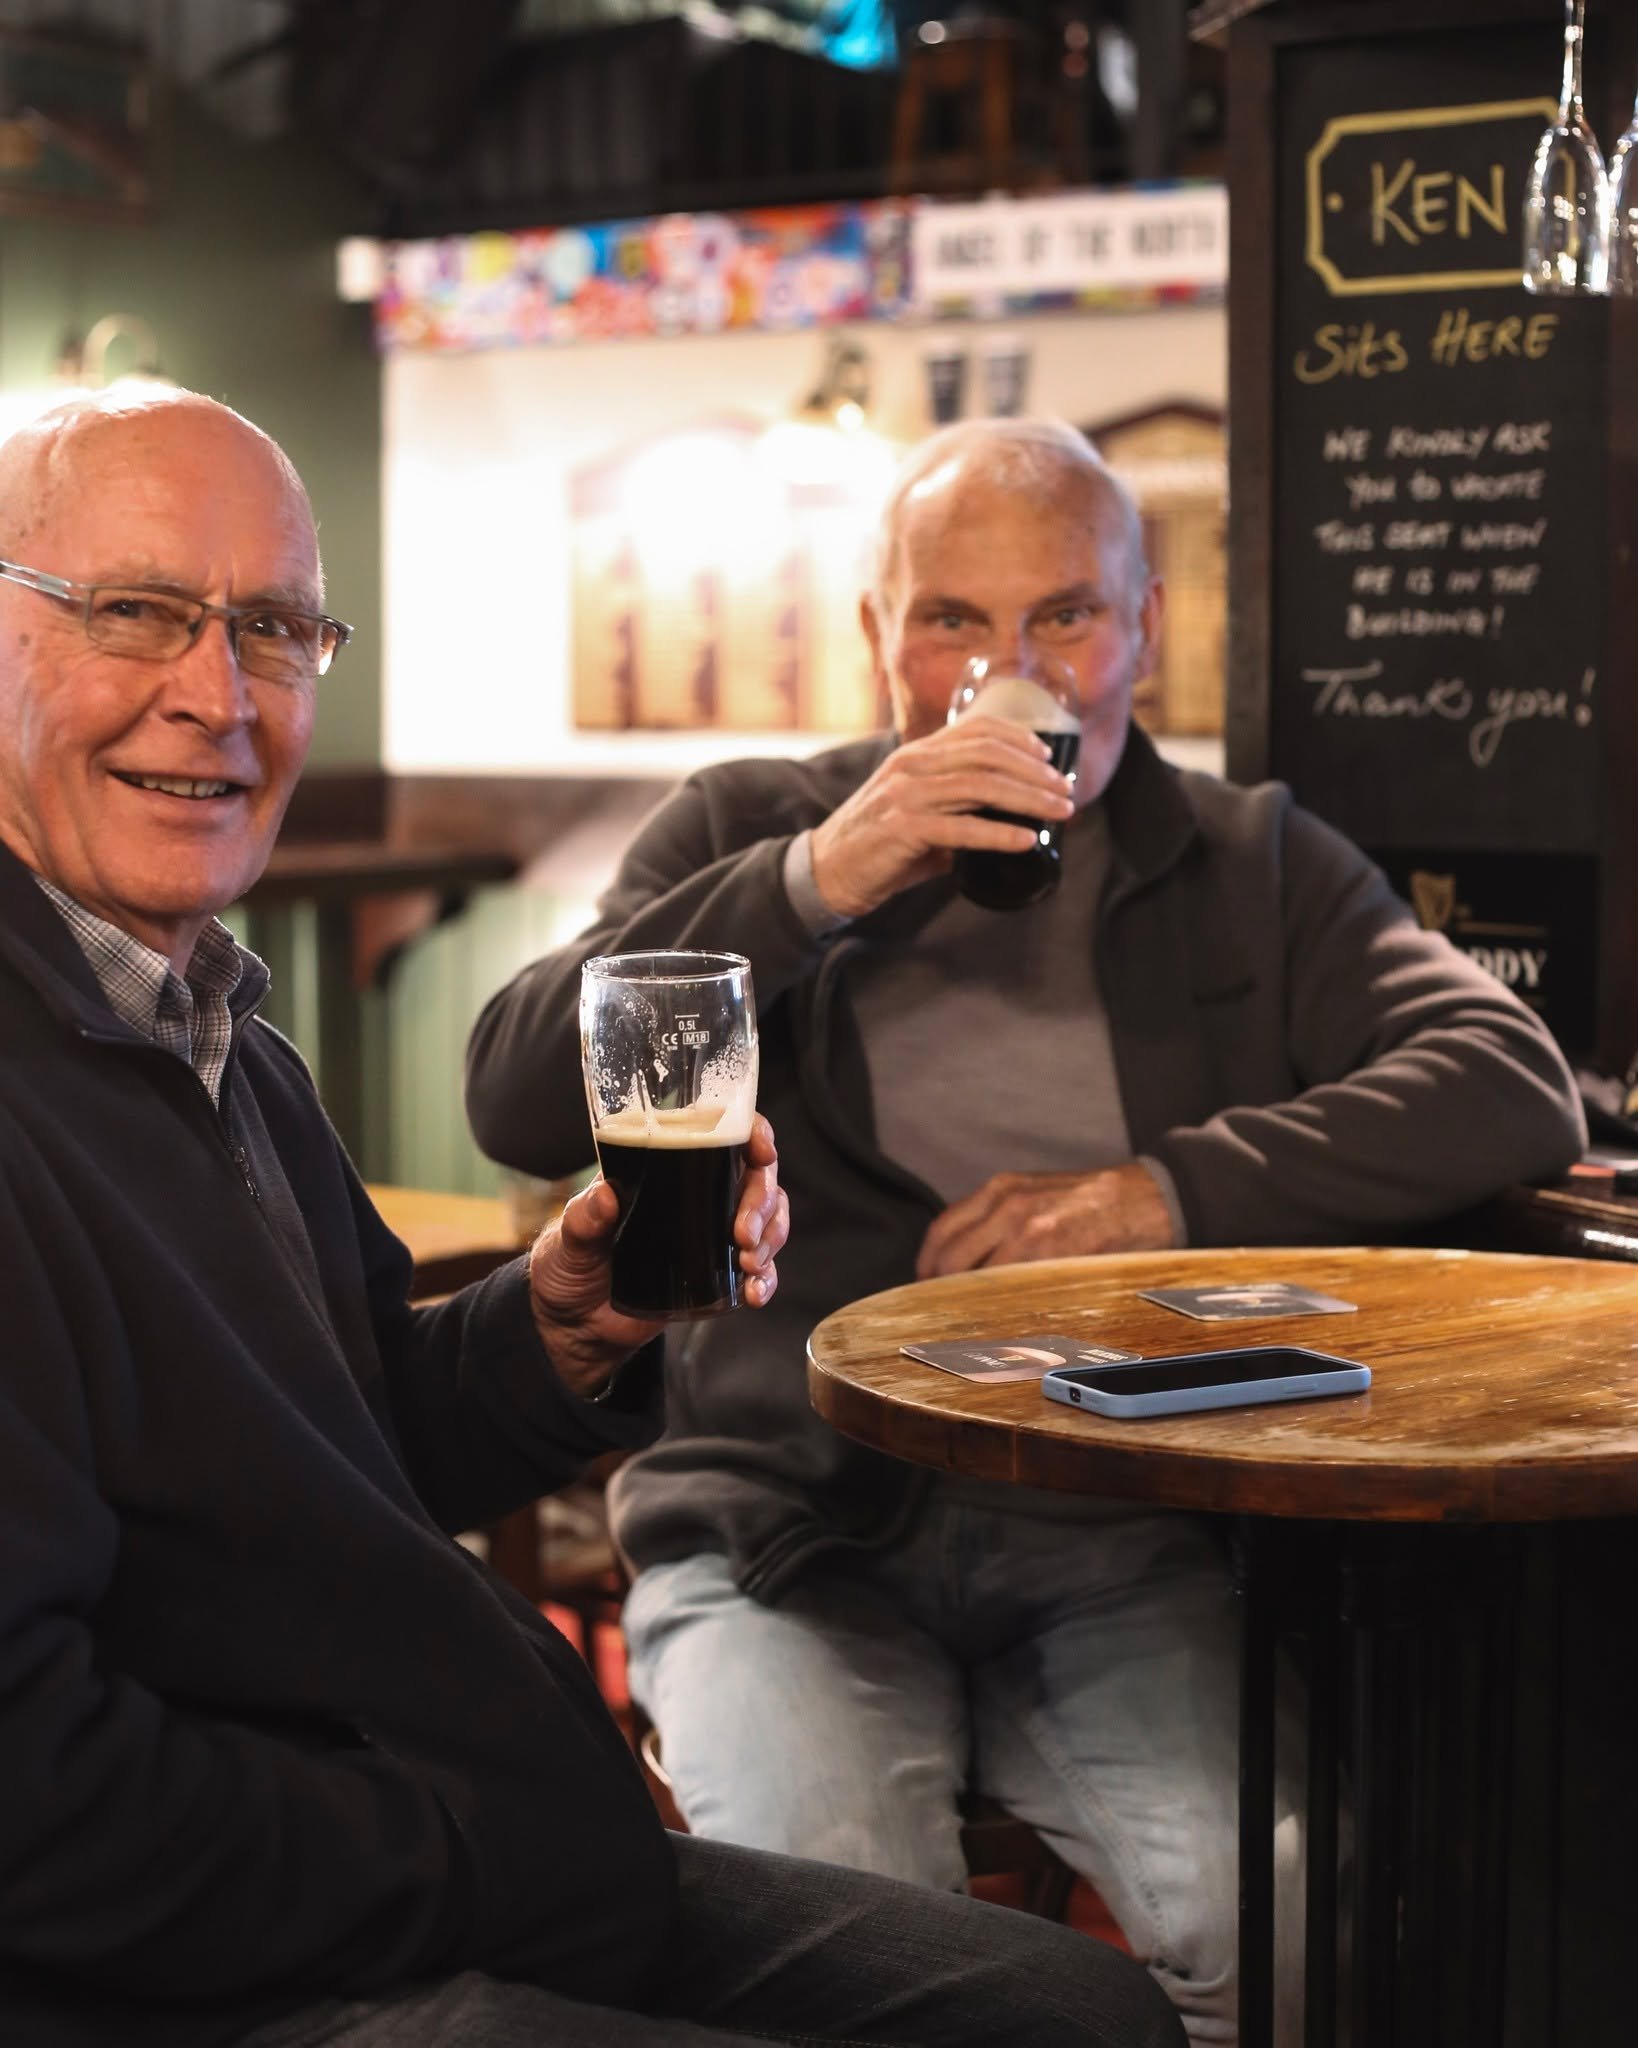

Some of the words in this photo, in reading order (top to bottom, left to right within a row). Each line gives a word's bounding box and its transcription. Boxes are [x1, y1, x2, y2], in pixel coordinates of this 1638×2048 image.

[1370, 160, 1508, 245] KEN
[1294, 322, 1408, 383] Sits
[1431, 308, 1559, 367] HERE
[1494, 423, 1551, 454] ASK
[686, 1033, 706, 1043] M18
